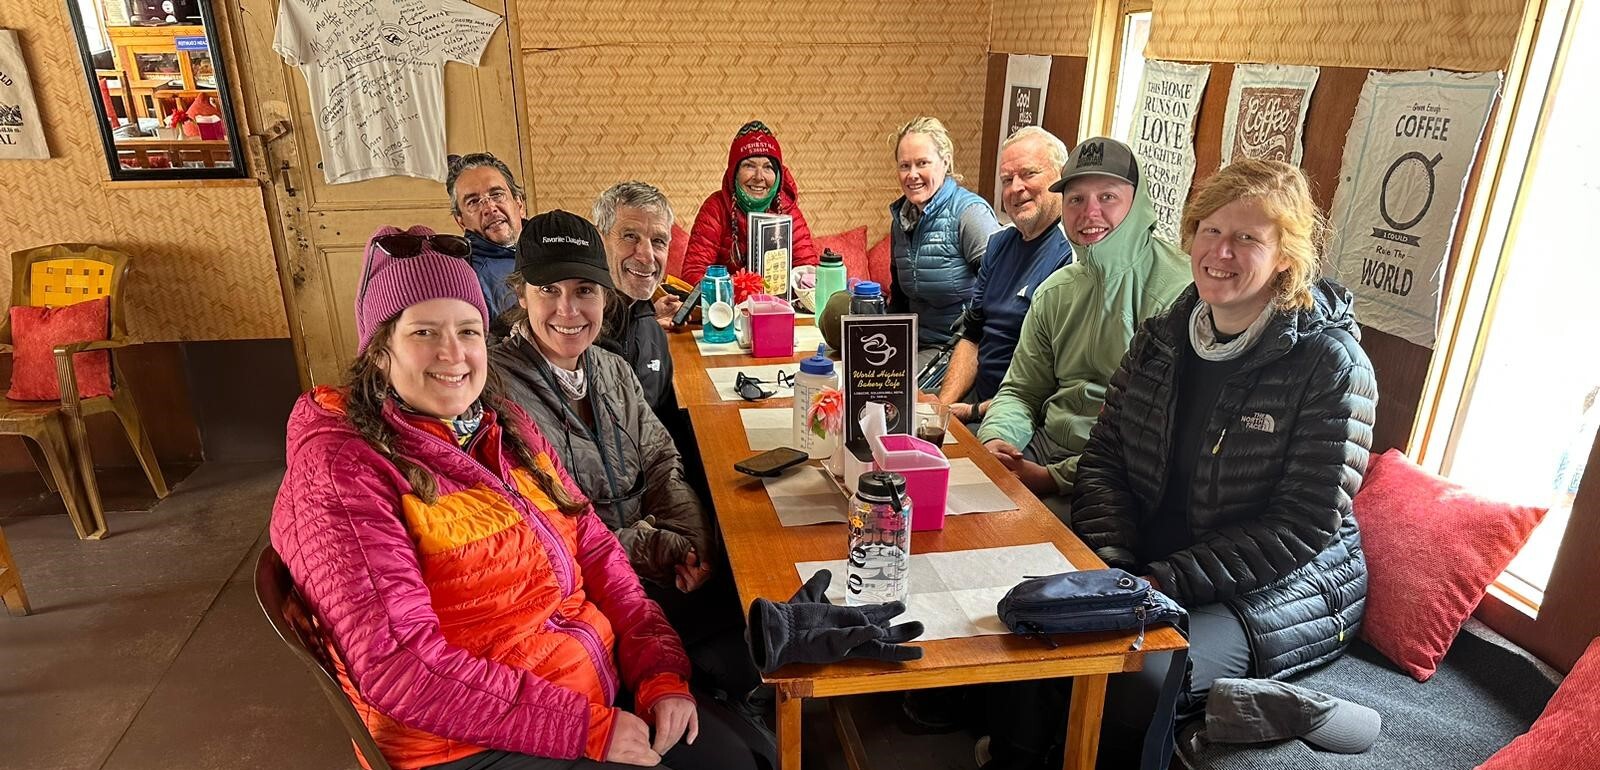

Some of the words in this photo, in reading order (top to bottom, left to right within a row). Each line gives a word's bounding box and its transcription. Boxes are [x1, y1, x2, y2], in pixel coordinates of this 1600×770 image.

[1161, 80, 1192, 99] HOME
[1144, 95, 1171, 116] RUNS
[1172, 101, 1189, 118] ON
[1244, 96, 1293, 145] Coffee
[1395, 114, 1451, 141] COFFEE
[1141, 115, 1185, 149] LOVE
[1138, 143, 1183, 166] LAUGHTER
[1148, 163, 1170, 183] CUPS
[1171, 171, 1180, 185] of
[1147, 180, 1177, 205] RONG
[542, 235, 565, 244] Favorite
[565, 235, 590, 247] Daughter
[1387, 231, 1408, 242] COULD
[1394, 248, 1406, 259] The
[1360, 257, 1413, 297] WORLD
[853, 369, 875, 378] World
[876, 369, 906, 380] Highest
[857, 379, 883, 390] Bakery
[884, 379, 901, 389] Cafe
[1240, 415, 1264, 425] NORTH
[1245, 422, 1263, 431] FACE
